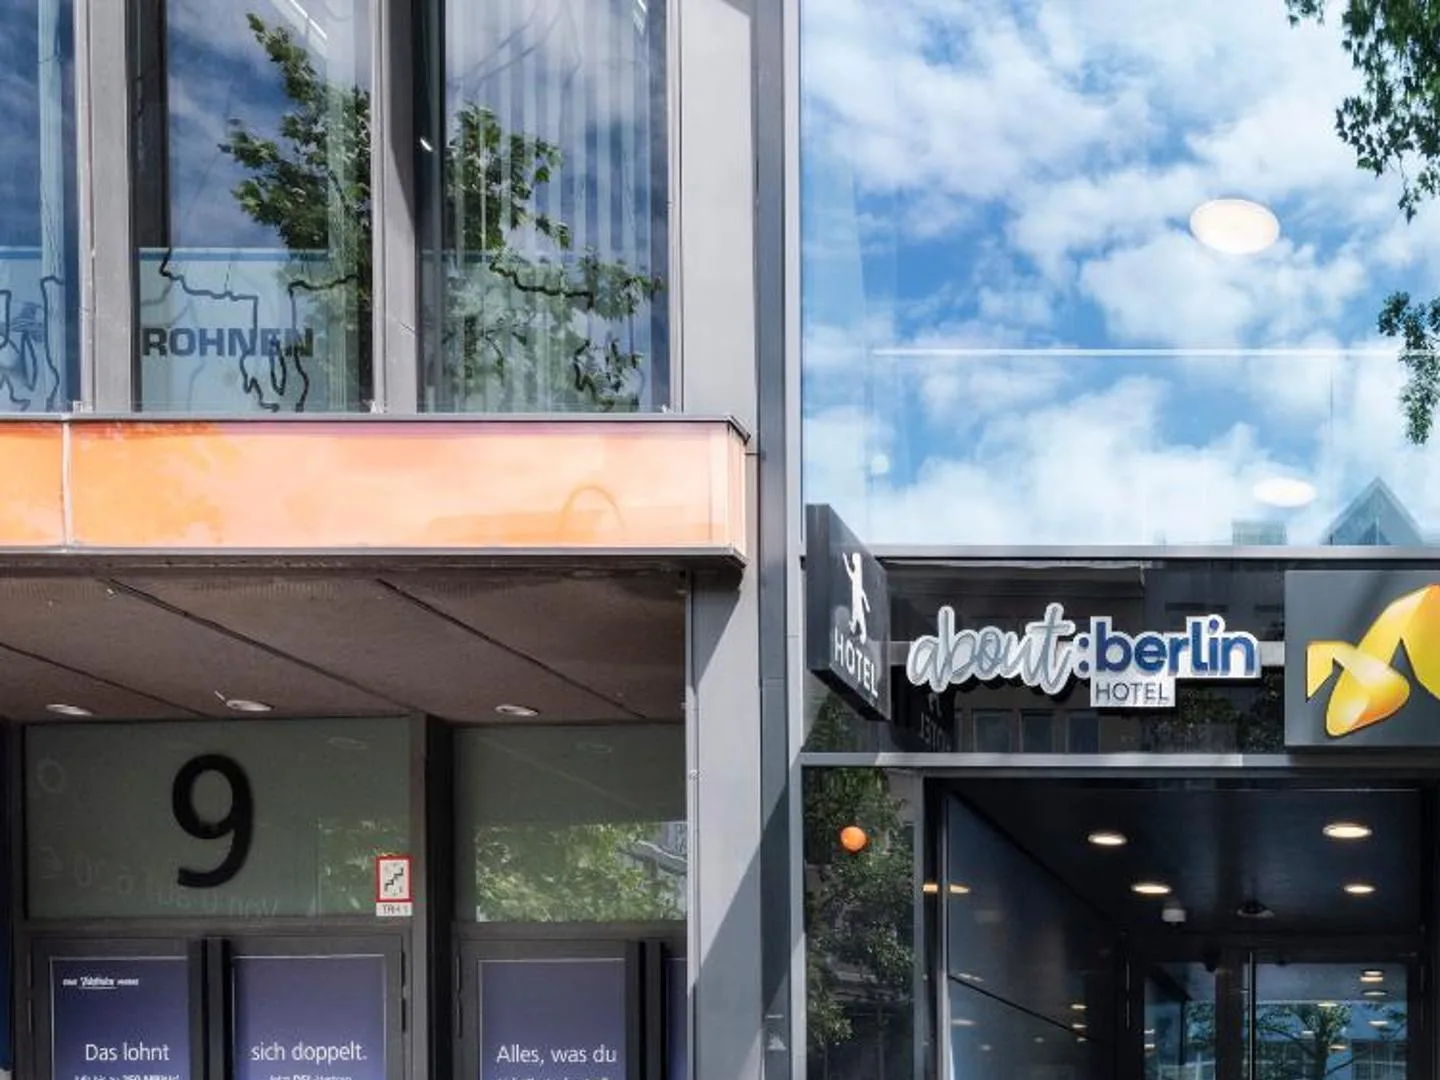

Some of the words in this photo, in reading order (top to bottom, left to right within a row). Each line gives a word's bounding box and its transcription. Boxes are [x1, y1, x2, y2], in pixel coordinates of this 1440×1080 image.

[833, 631, 879, 698] HOTEL
[1096, 684, 1169, 702] HOTEL
[172, 753, 254, 888] 9
[85, 1043, 118, 1061] Das
[123, 1041, 169, 1061] lohnt
[250, 1042, 285, 1061] sich
[291, 1041, 367, 1065] doppelt.
[497, 1044, 544, 1065] Alles,
[551, 1048, 586, 1062] was
[592, 1044, 617, 1062] du
